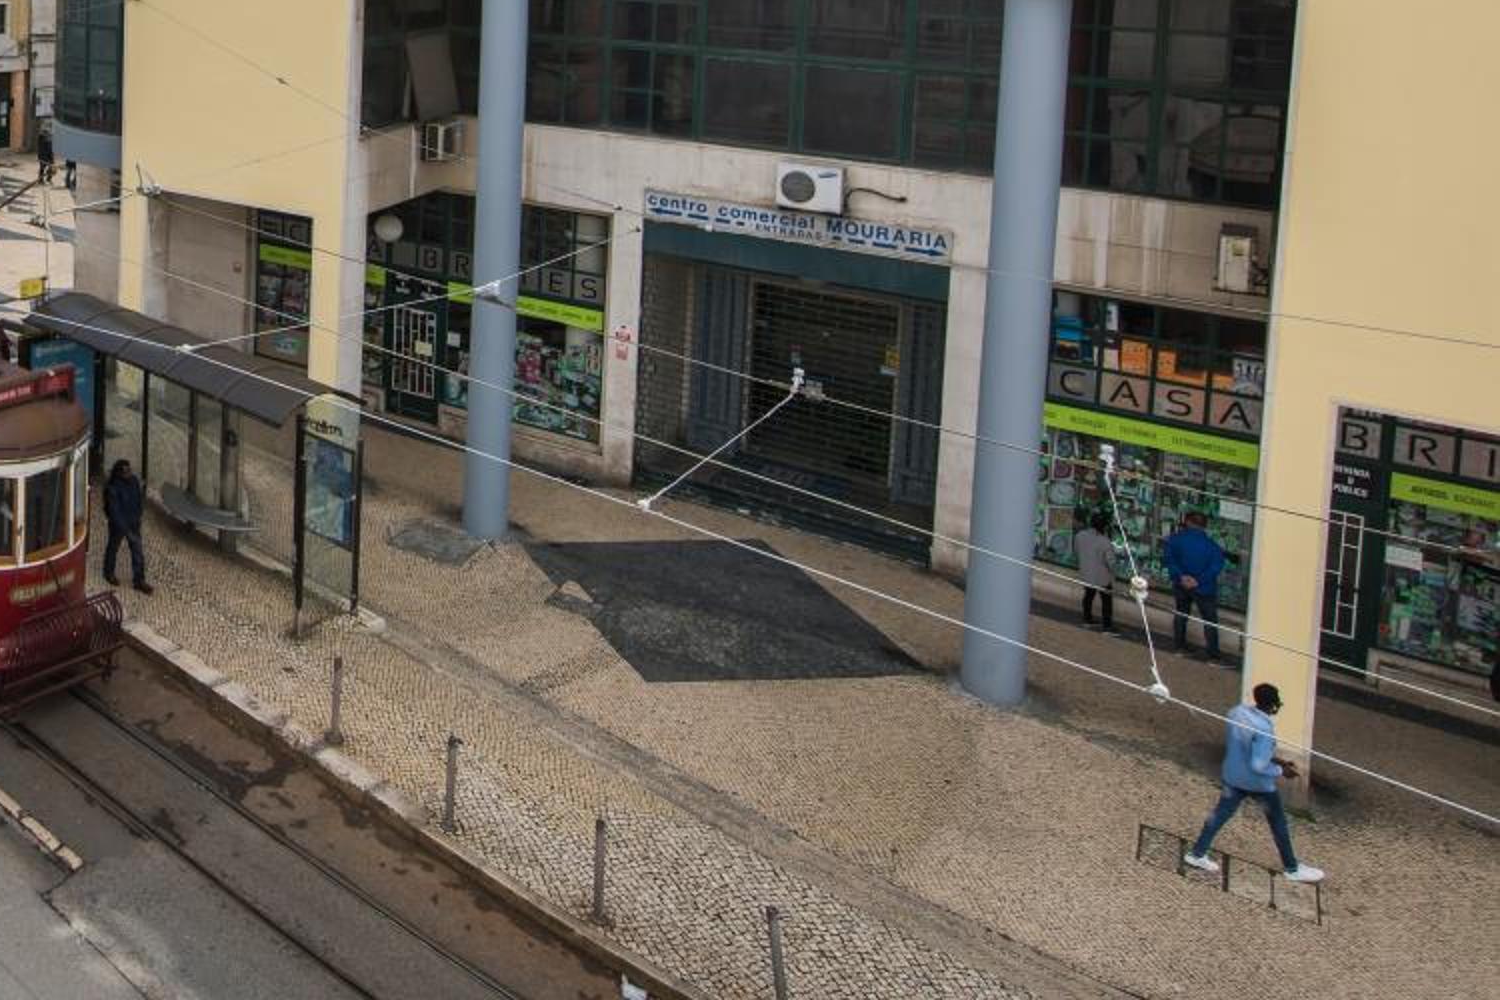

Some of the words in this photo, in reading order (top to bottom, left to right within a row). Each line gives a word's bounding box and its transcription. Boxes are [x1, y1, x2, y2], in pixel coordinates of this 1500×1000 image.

[648, 193, 708, 214] centro
[717, 205, 816, 231] comercial
[825, 217, 948, 250] MOURARIA
[1059, 369, 1253, 431] CASA
